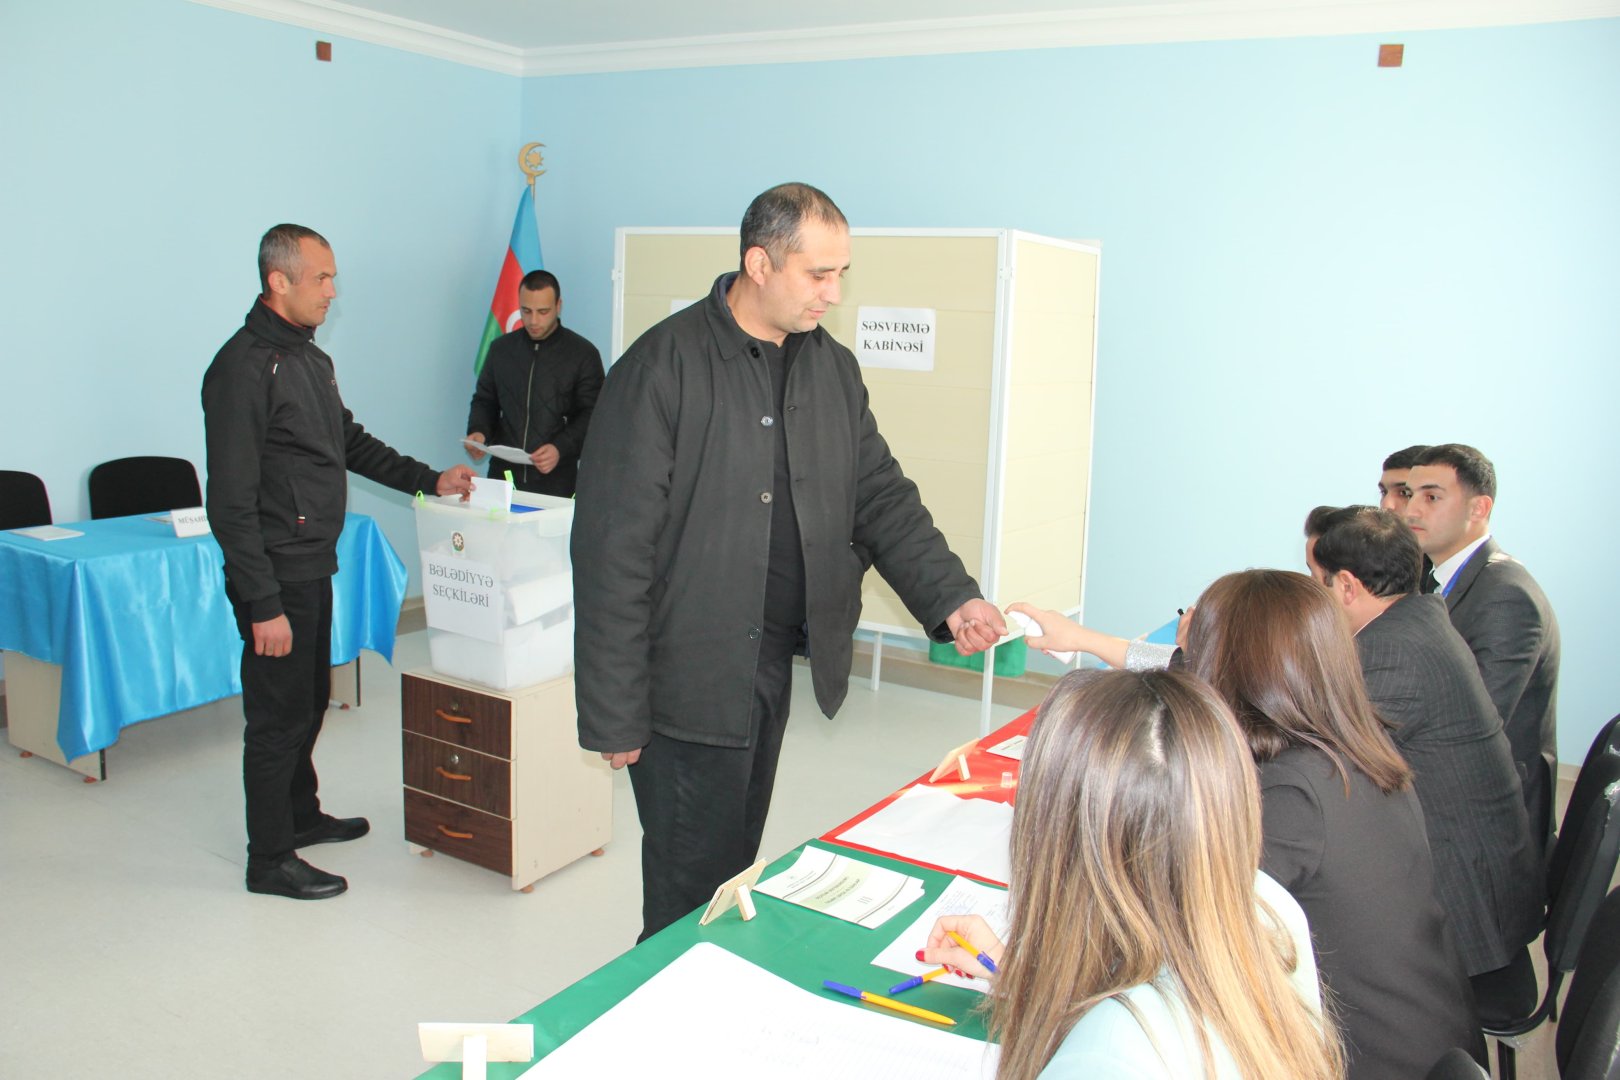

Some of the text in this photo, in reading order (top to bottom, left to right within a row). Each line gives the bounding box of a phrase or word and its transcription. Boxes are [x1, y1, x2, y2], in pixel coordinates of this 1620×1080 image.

[861, 320, 930, 334] SƏSVERMƏ
[863, 338, 924, 353] KABİNƏSİ
[429, 563, 494, 588] BƏLƏDİYYƏ
[433, 584, 489, 608] SEÇKİLƏRİ
